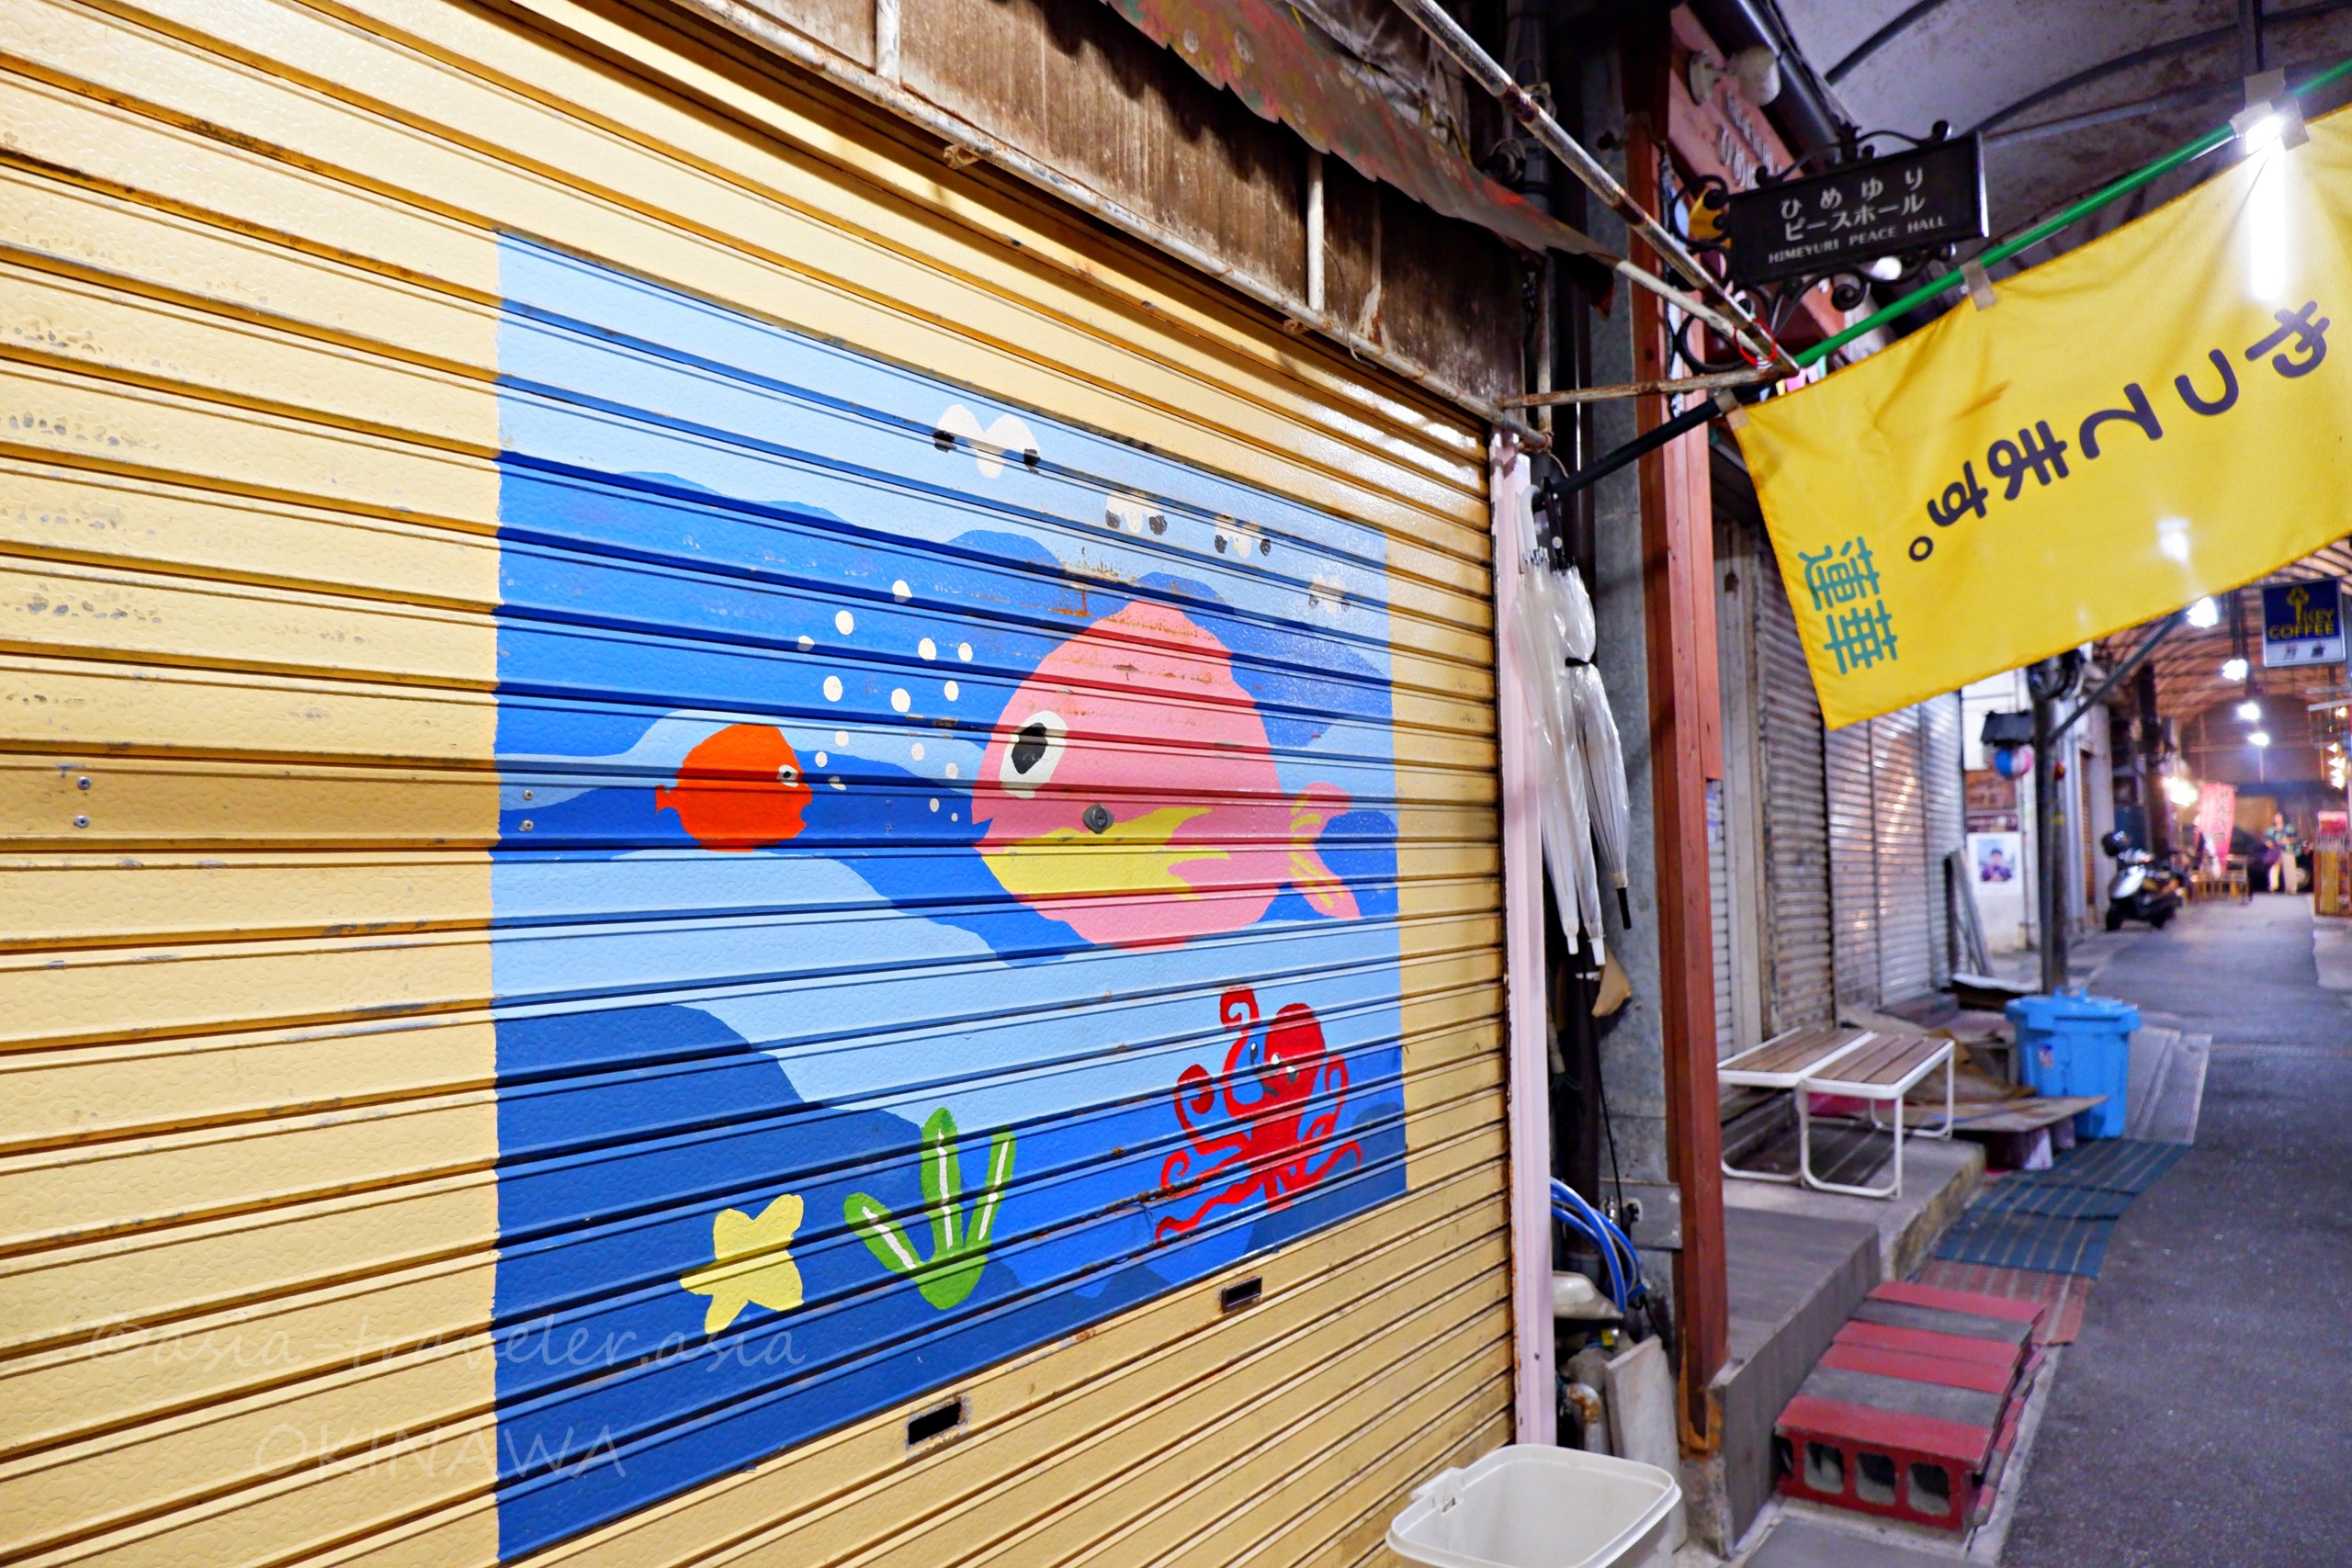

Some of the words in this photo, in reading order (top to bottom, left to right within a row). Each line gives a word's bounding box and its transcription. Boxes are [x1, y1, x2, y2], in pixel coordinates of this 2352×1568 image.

[1781, 166, 1923, 220] ひめゆり
[1784, 192, 1926, 243] ピースホール
[1769, 238, 1839, 264] HIMEYURI
[1849, 225, 1898, 245] PEACE
[1907, 215, 1947, 234] HALL
[1798, 536, 1898, 675] 蓮華
[2304, 608, 2335, 624] KEY
[2268, 622, 2335, 640] COFFEE
